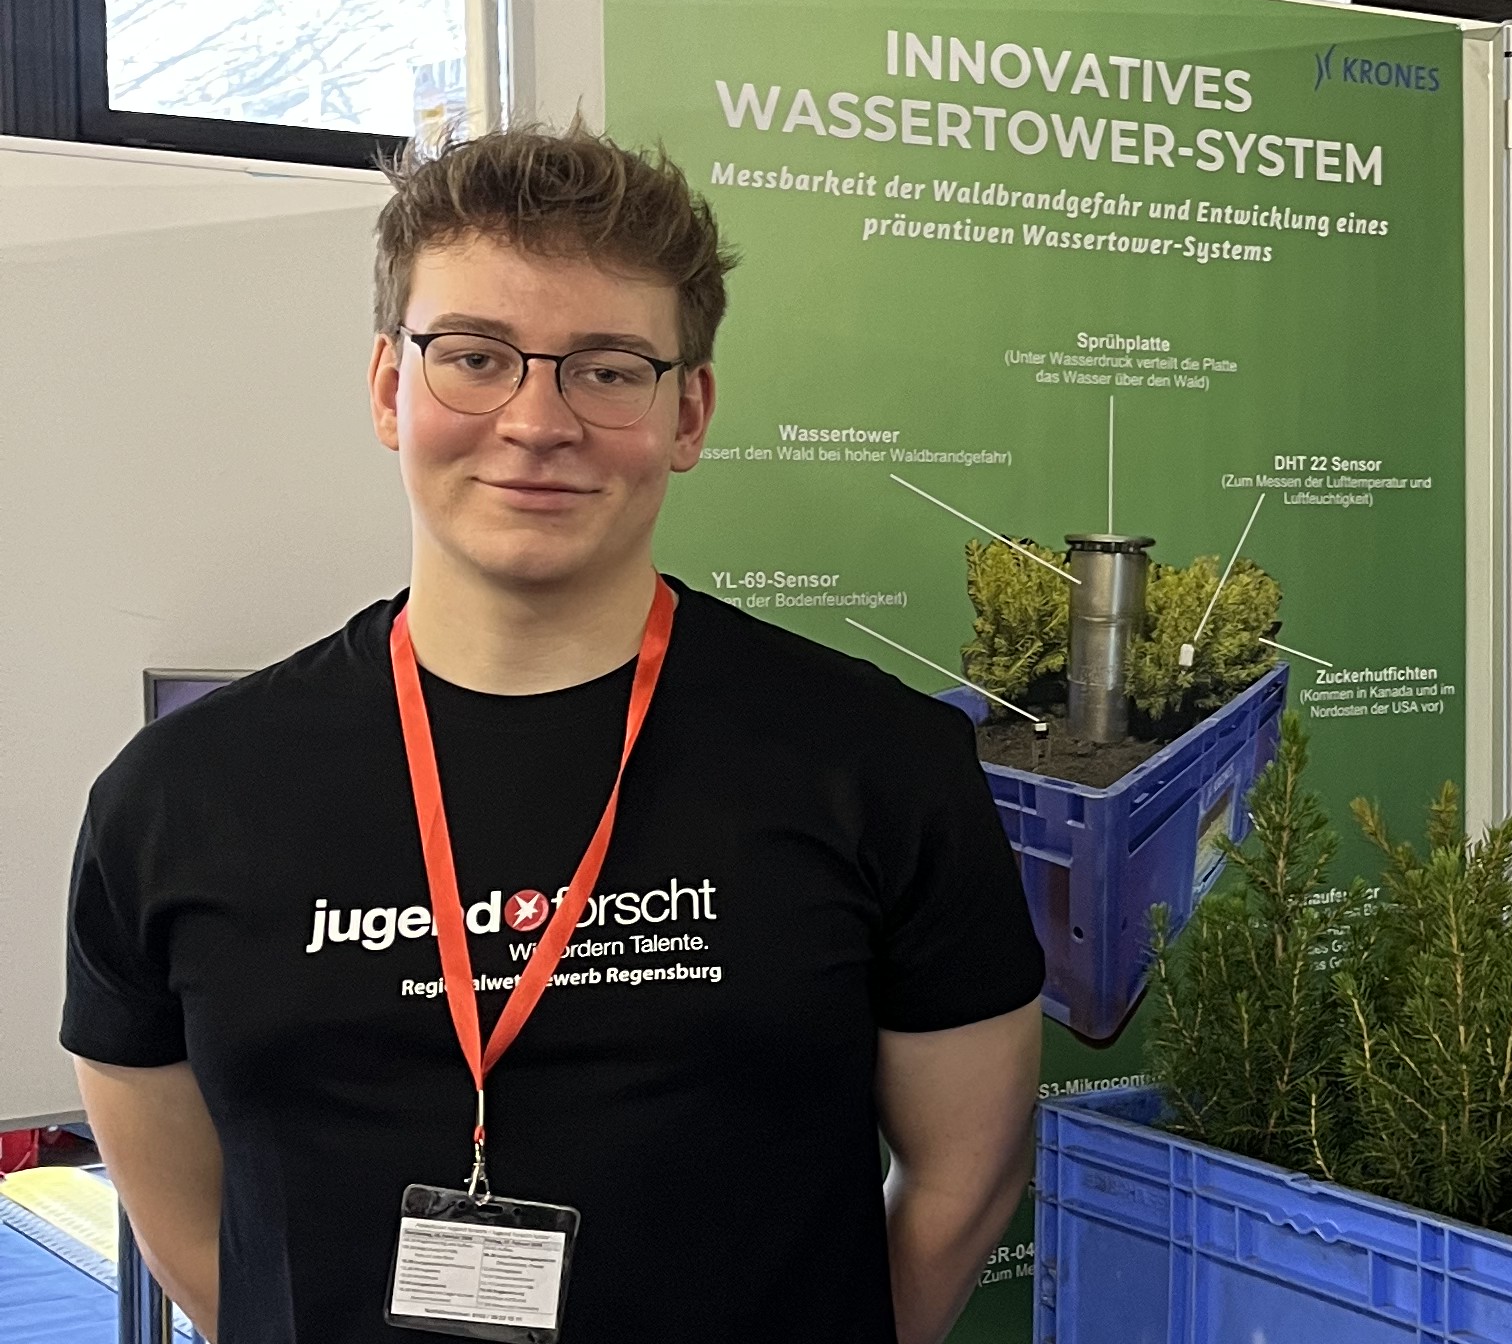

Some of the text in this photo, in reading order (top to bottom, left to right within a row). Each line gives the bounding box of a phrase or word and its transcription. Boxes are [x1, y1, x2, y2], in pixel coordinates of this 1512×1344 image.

[886, 29, 1252, 113] INNOVATIVES
[1343, 56, 1440, 92] KRONES
[715, 79, 1382, 186] WASSERTOWER-SYSTEM
[710, 161, 1389, 237] Messbarkeit der Waldbrandgefahr und Entwicklung eines
[862, 212, 1272, 264] präventiven Wassertower-Systems
[1076, 331, 1170, 354] Sprühplatte
[1048, 351, 1133, 368] Wasserdruck
[1135, 356, 1178, 370] verteilt
[1179, 356, 1200, 371] die
[1201, 356, 1237, 372] Platte
[1035, 368, 1060, 383] das
[1061, 369, 1112, 385] Wasser
[1114, 371, 1144, 386] über
[1146, 373, 1171, 387] den
[778, 423, 900, 443] Wassertower
[743, 445, 773, 460] den
[775, 445, 815, 461] Wald
[817, 445, 841, 461] bei
[844, 446, 887, 462] hoher
[1274, 454, 1382, 471] DHT 22 Sensor
[1255, 473, 1302, 488] Messen
[1303, 474, 1324, 488] der
[1325, 474, 1408, 491] Lufttemperatur
[1408, 476, 1432, 489] und
[710, 570, 840, 589] YL-69-Sensor
[745, 592, 771, 608] der
[1315, 665, 1437, 684] Zuckerhutfichten
[1355, 686, 1367, 699] in
[1368, 684, 1414, 698] Kanada
[1414, 682, 1438, 696] und
[1439, 682, 1455, 695] im
[1309, 704, 1368, 718] Nordosten
[1369, 701, 1390, 715] der
[1391, 700, 1419, 714] USA
[508, 942, 540, 962] Wi
[629, 934, 709, 954] Talente.
[605, 963, 722, 985] Regensburg
[1015, 1262, 1035, 1277] Me
